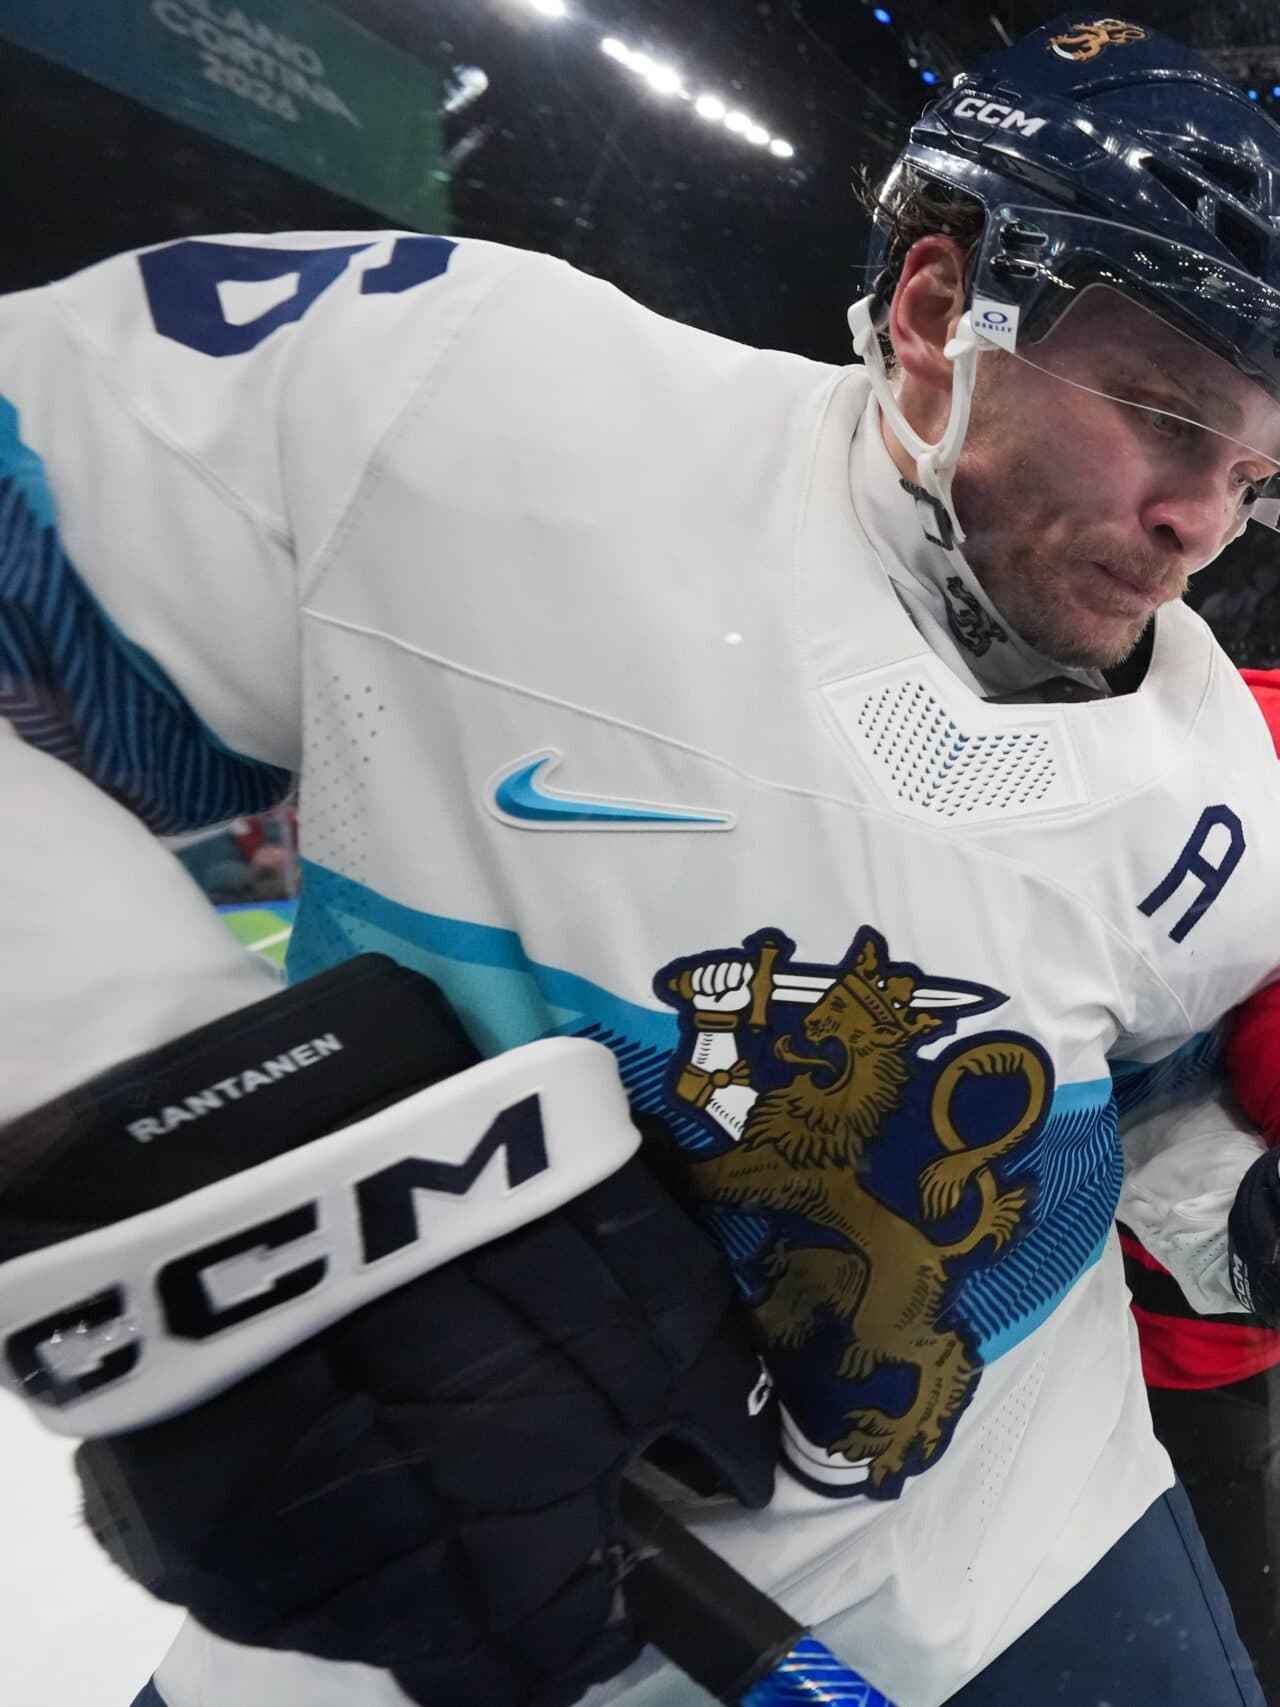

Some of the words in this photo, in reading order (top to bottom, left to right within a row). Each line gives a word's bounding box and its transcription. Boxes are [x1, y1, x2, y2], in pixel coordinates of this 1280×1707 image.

[953, 97, 1047, 137] CCM
[1137, 804, 1247, 944] A
[126, 1033, 344, 1143] RANTANEN
[4, 1092, 550, 1409] CCM
[1232, 1252, 1252, 1311] CCM
